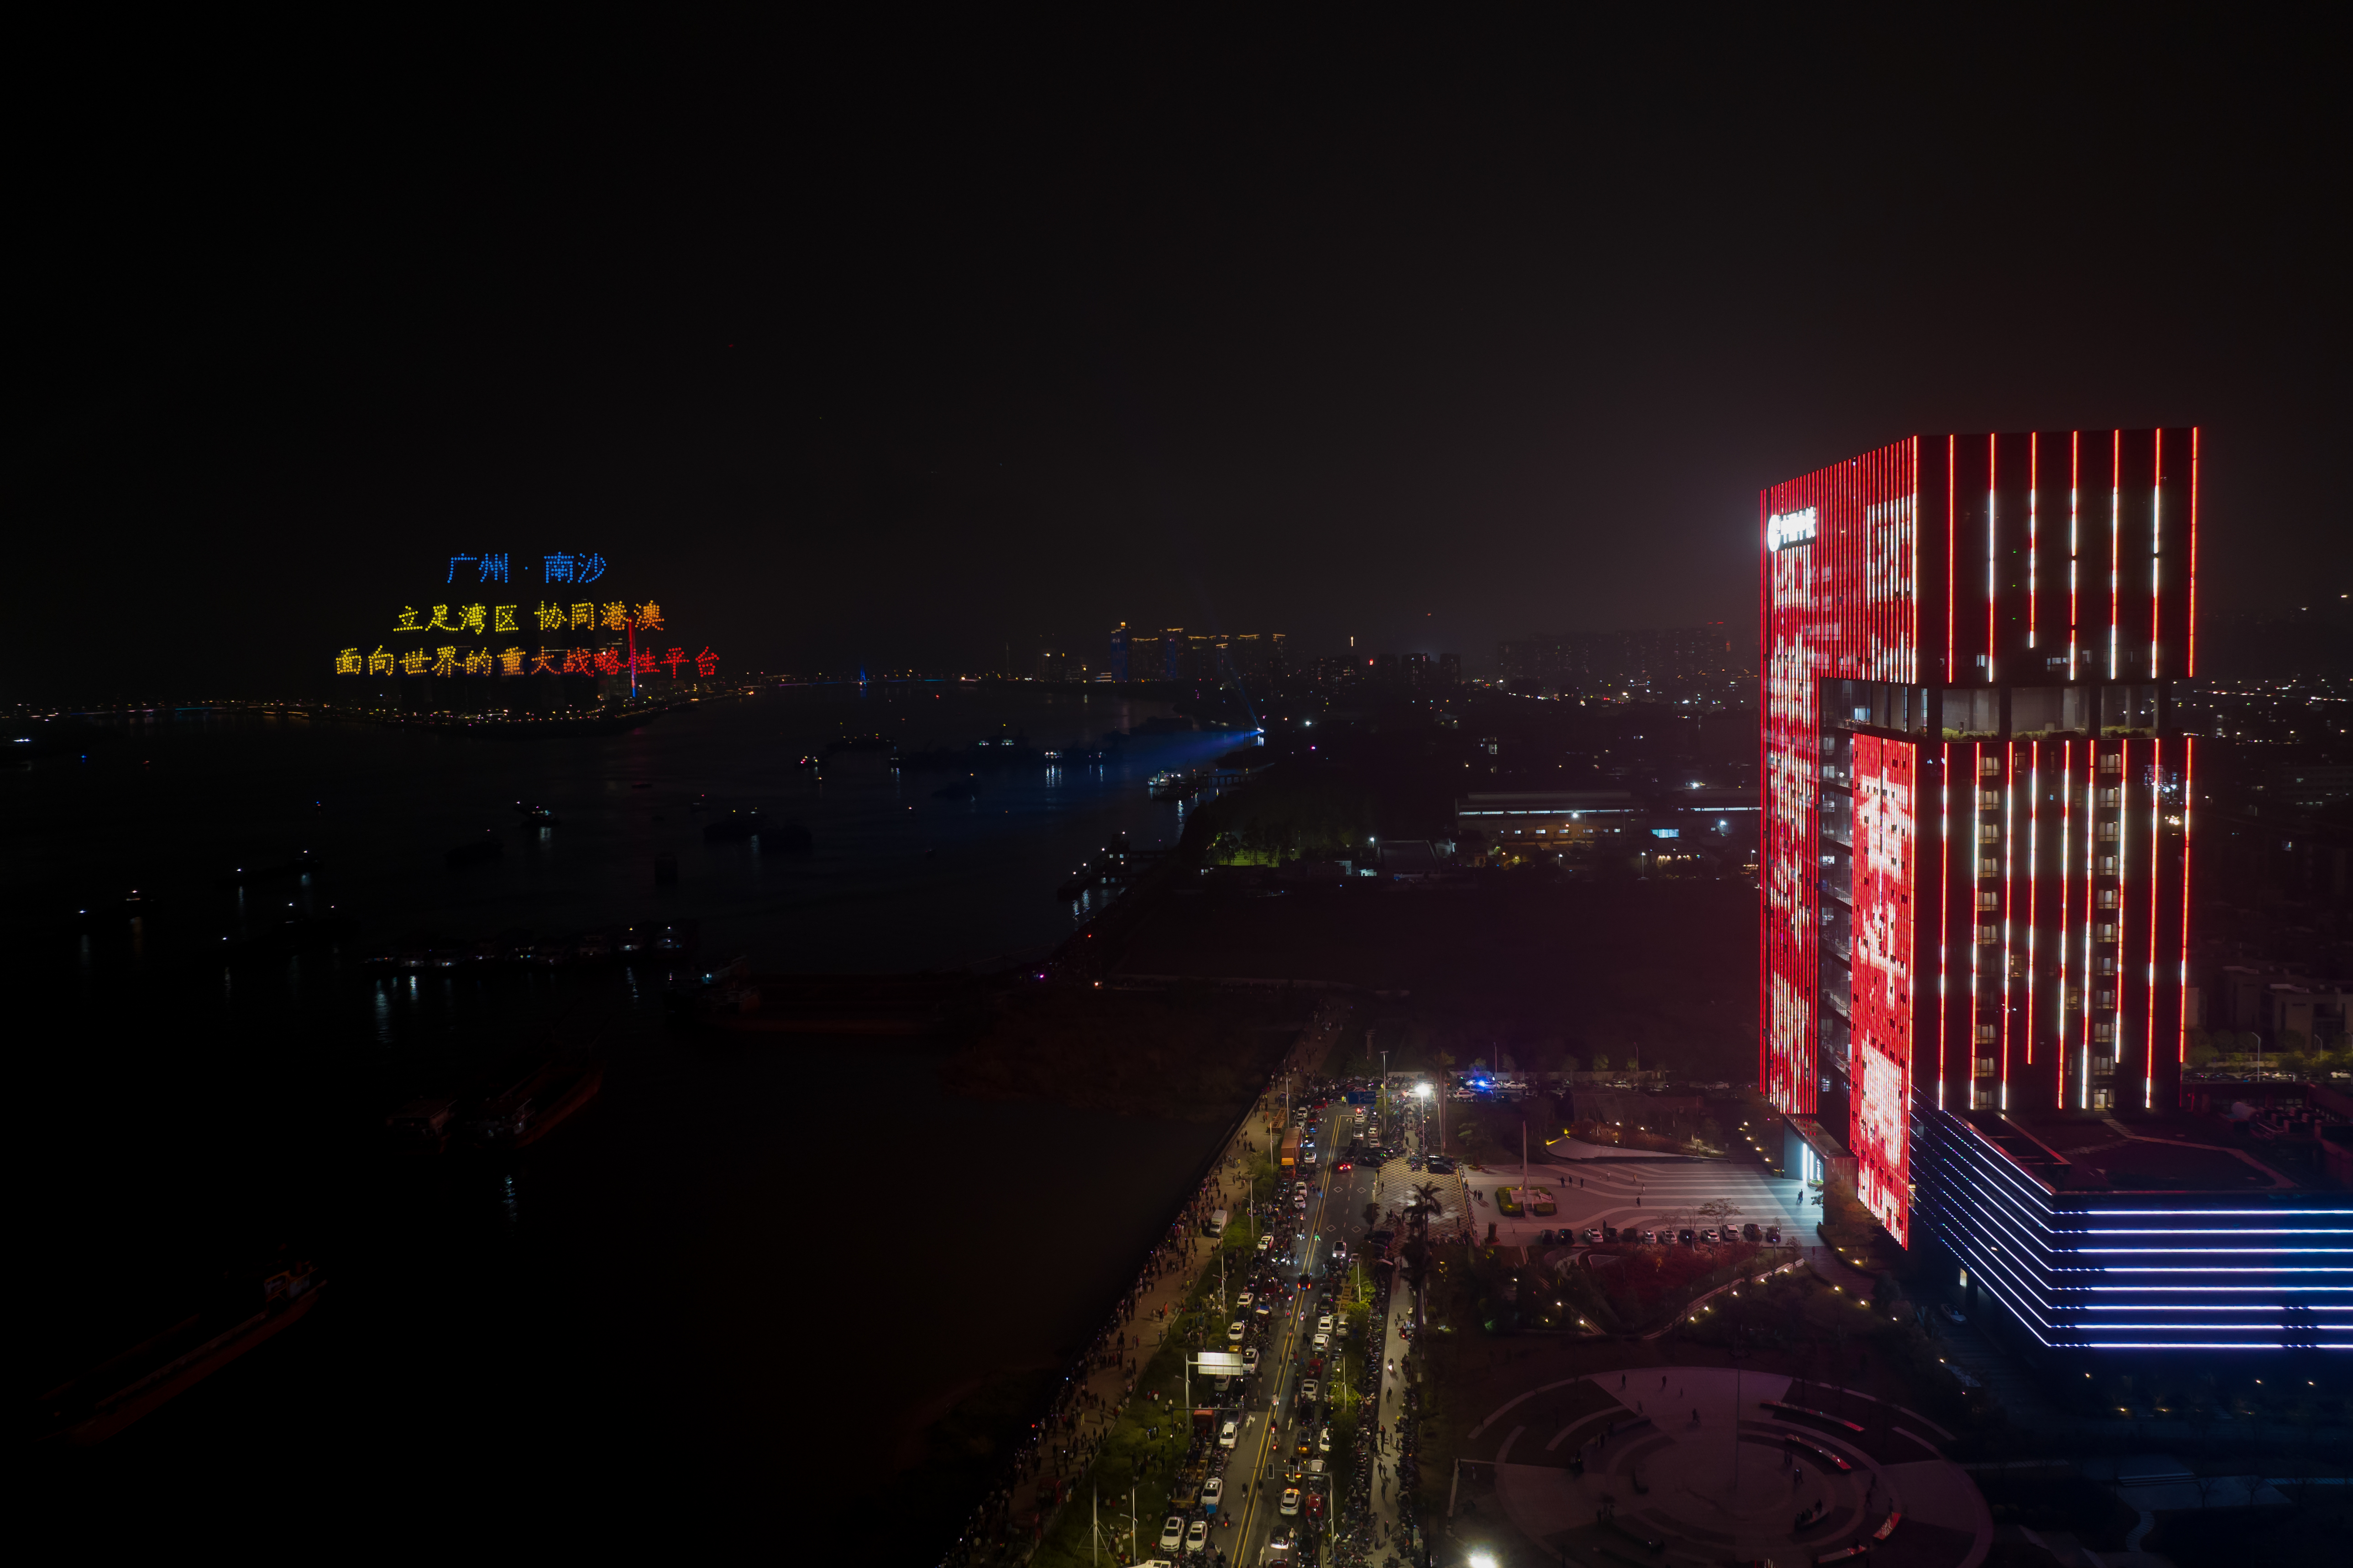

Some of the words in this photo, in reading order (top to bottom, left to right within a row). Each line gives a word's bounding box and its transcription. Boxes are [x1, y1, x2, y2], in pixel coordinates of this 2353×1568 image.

[393, 603, 519, 634] 立足湾区
[534, 601, 665, 631] 协同港澳
[335, 645, 720, 677] 面向世界的重大战略性平台
